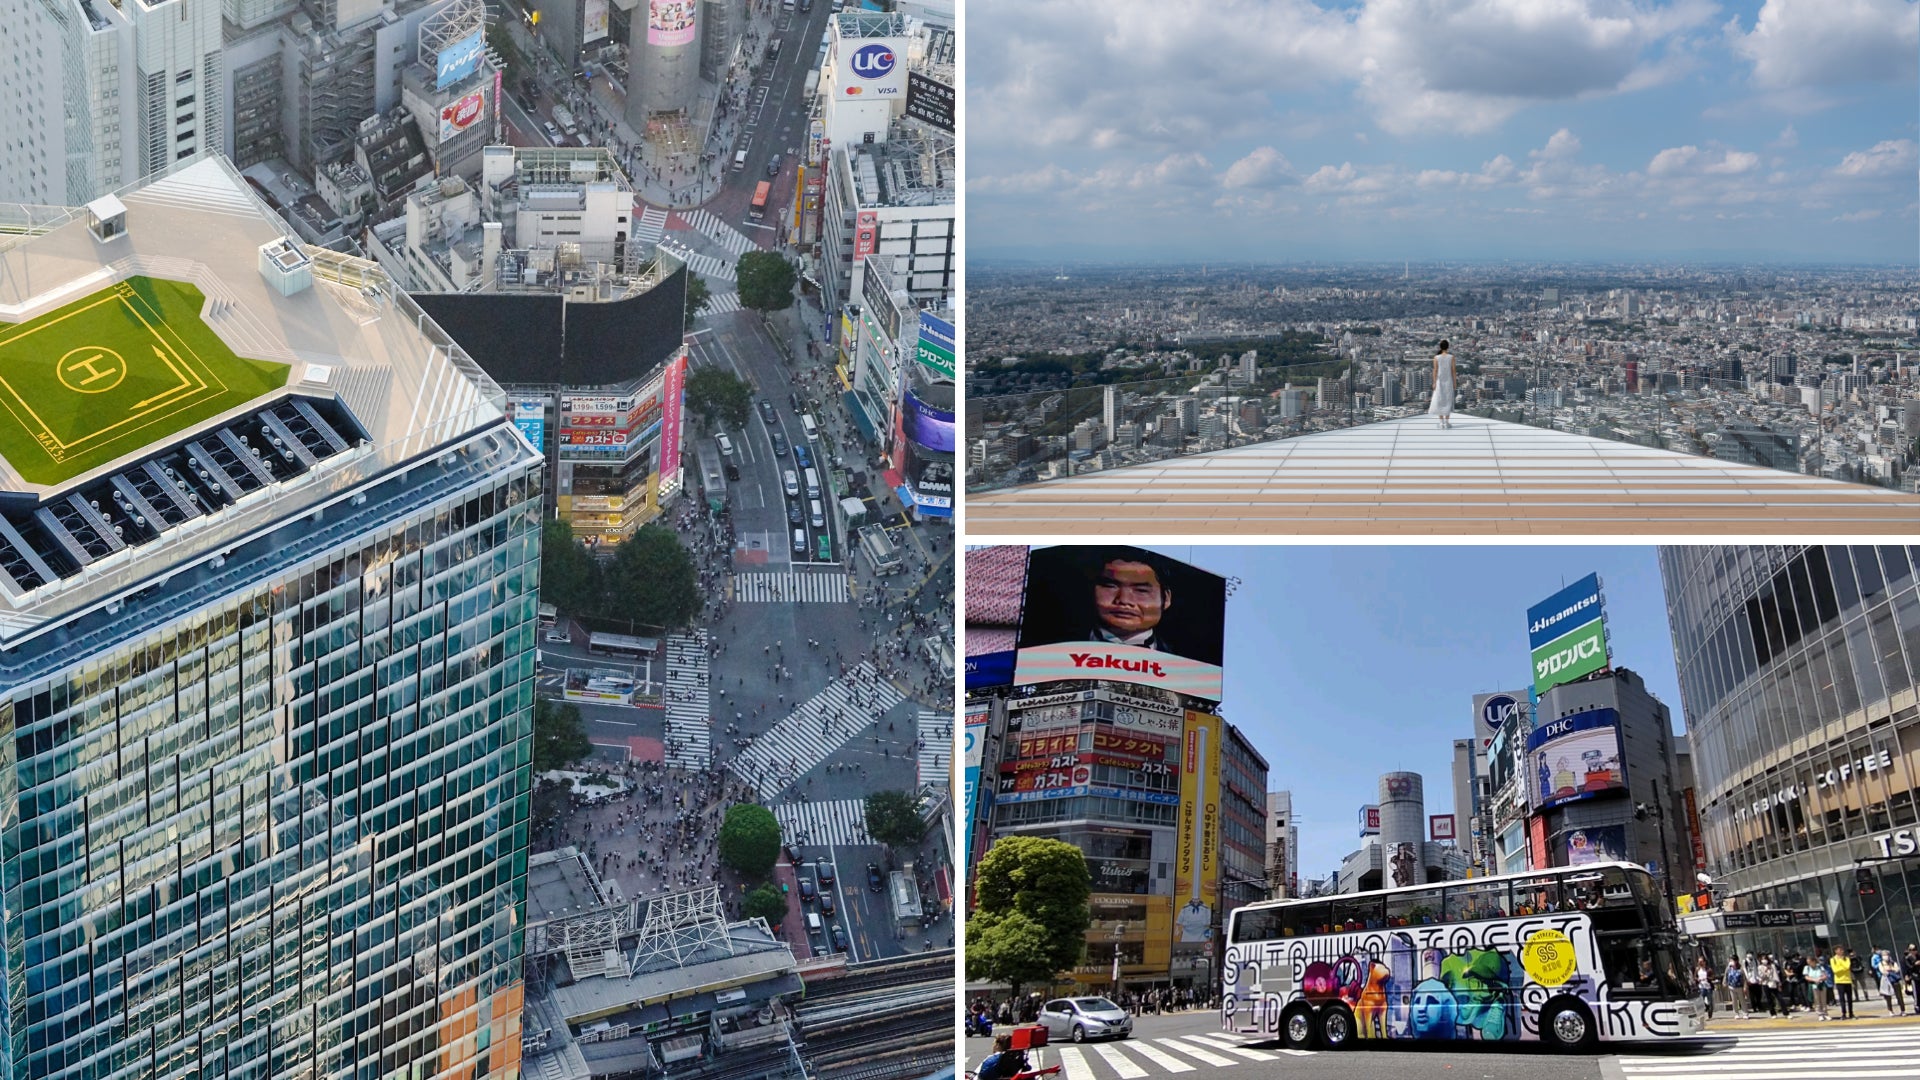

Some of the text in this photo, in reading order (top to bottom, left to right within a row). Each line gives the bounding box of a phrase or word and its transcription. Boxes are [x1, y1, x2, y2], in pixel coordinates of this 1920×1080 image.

[854, 52, 894, 71] UC
[67, 353, 117, 386] H
[919, 405, 937, 418] DHC
[585, 435, 611, 443] ガスト
[918, 481, 951, 492] DMM
[1529, 593, 1598, 634] Hisamitsu
[1070, 653, 1167, 678] Yakult
[1536, 635, 1601, 680] サロンパス
[1010, 717, 1022, 725] 9F
[1137, 711, 1180, 731] しゃぶ葉
[1546, 718, 1574, 738] DHC
[1094, 734, 1163, 756] コンタクト
[1050, 756, 1080, 768] ガスト
[1141, 760, 1173, 775] ガスト
[1816, 749, 1892, 790] COFFEE
[1001, 779, 1015, 789] 7F
[1034, 773, 1070, 789] ガスト
[1873, 830, 1920, 858] TS
[1537, 943, 1557, 963] SS
